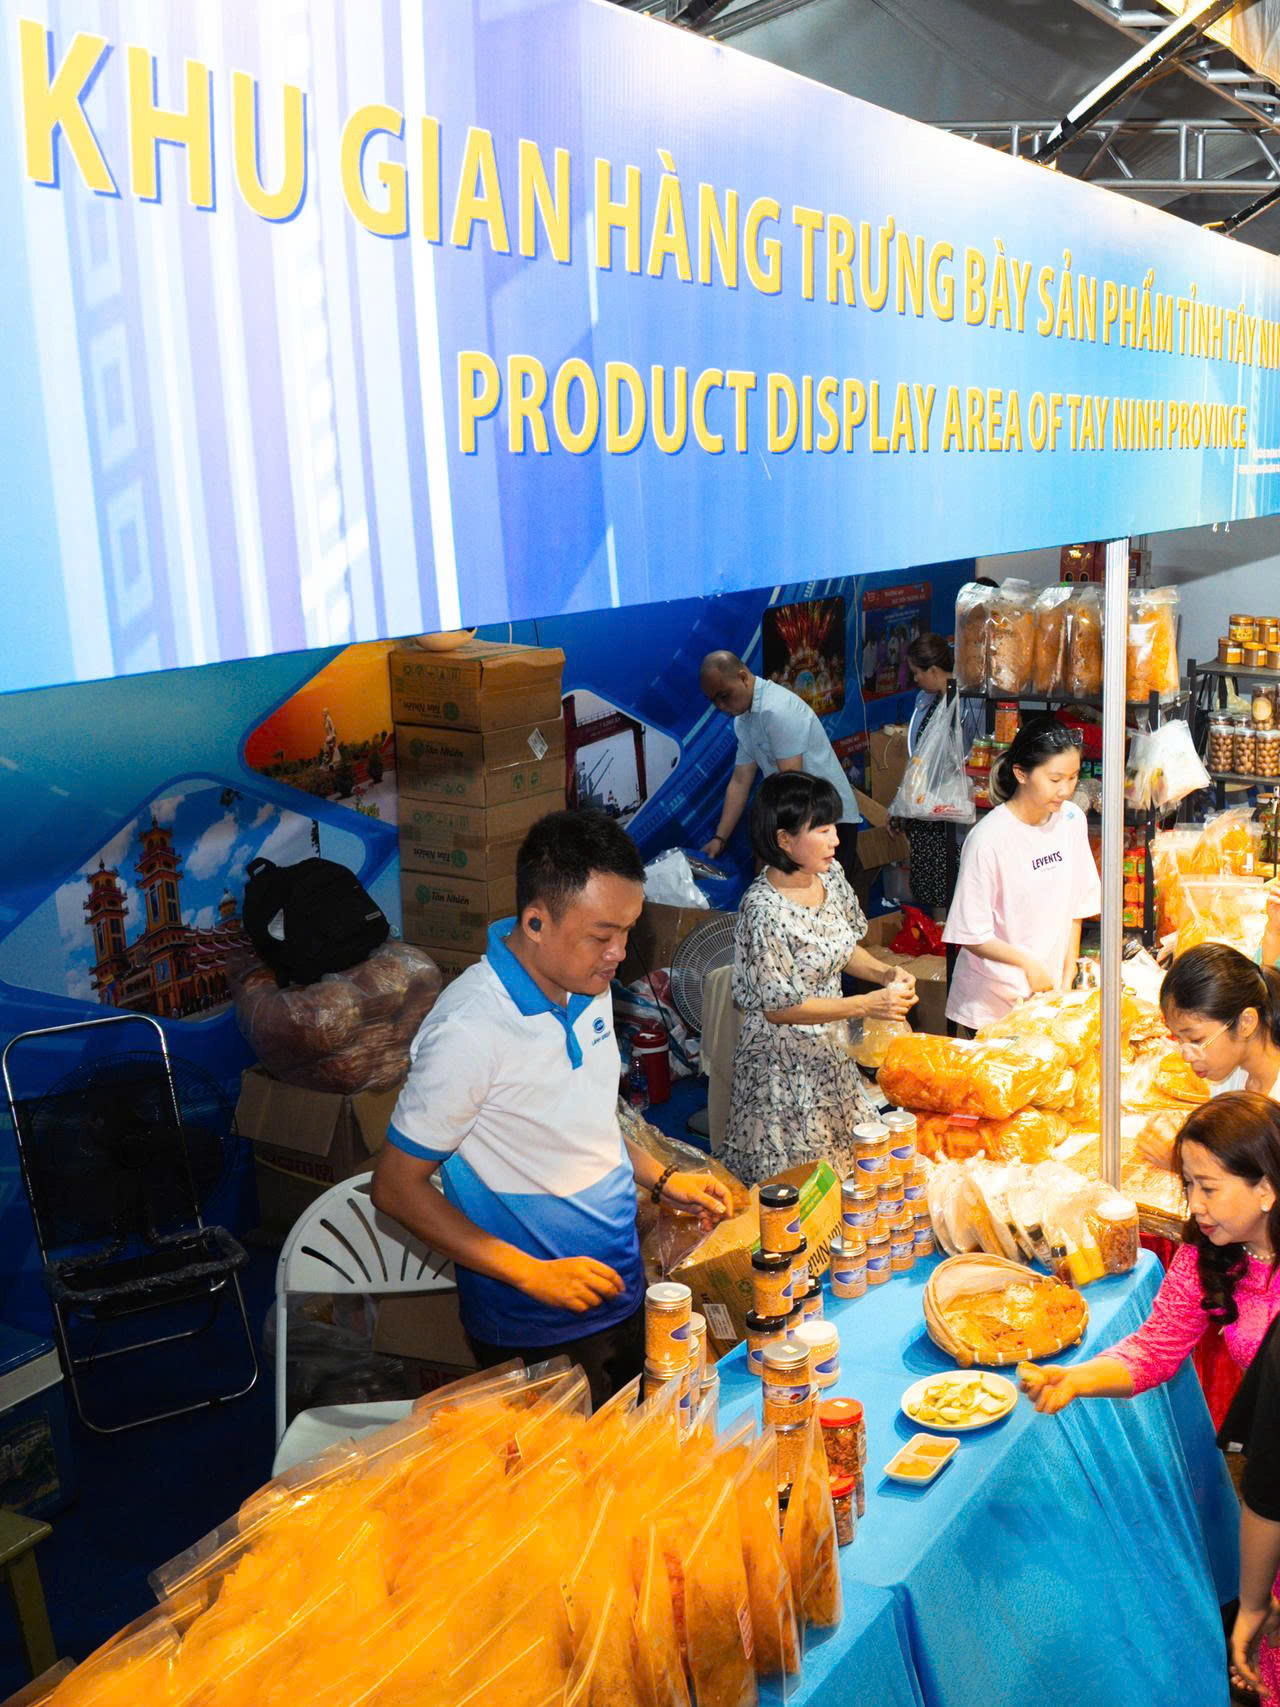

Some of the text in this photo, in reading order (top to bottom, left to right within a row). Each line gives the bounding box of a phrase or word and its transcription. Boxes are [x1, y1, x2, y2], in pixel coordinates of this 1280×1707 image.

[17, 17, 308, 223] KHU
[340, 102, 573, 265] GIAN
[594, 148, 785, 295] HÀNG
[792, 204, 955, 322] TRƯNG
[964, 236, 1033, 334] BÀY
[1037, 247, 1098, 343] SẢN
[1103, 267, 1175, 355] PHẨM
[1176, 281, 1224, 361] TỈNH
[1225, 302, 1257, 368] TÂY
[457, 350, 1247, 456] PRODUCT DISPLAY AREA OF TAY NINH PROVINCE
[1031, 850, 1063, 871] LEVENTS
